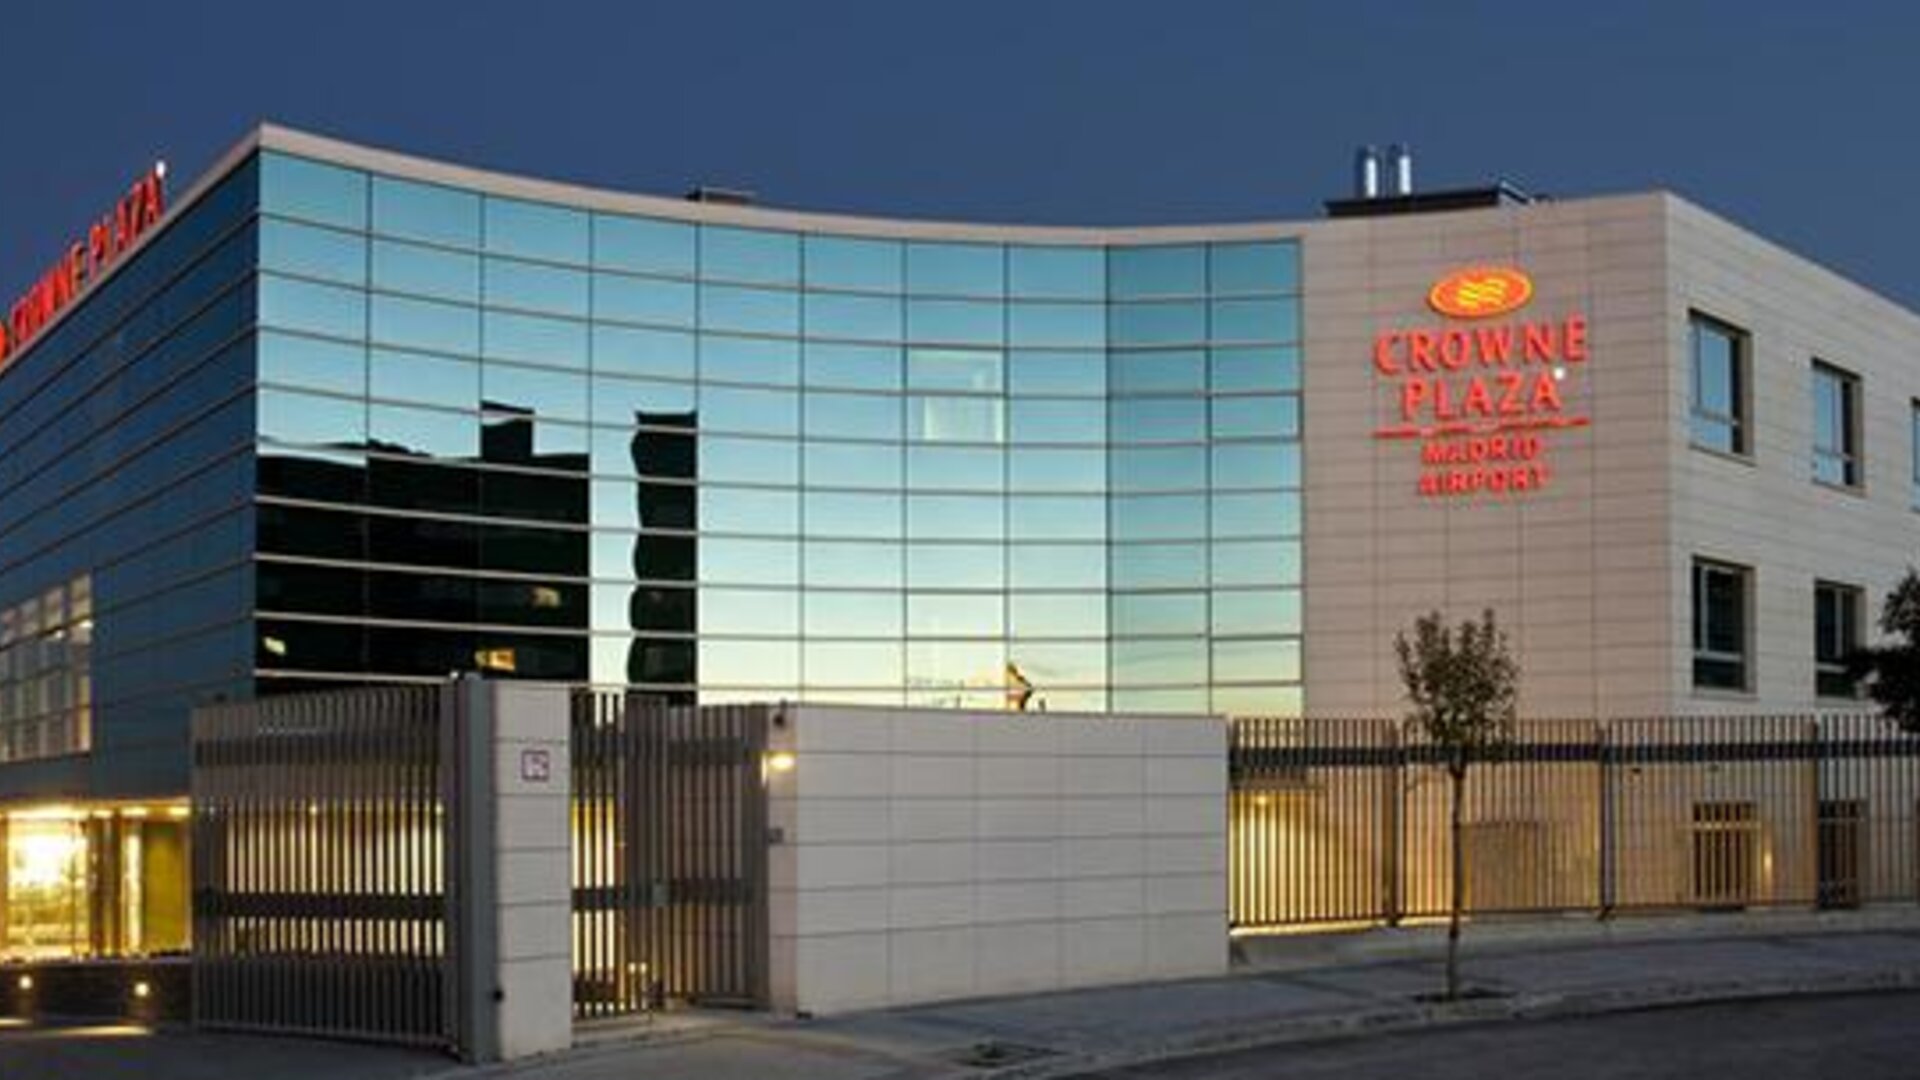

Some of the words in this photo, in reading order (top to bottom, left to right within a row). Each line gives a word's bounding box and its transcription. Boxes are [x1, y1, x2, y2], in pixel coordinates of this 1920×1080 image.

[87, 170, 165, 281] PLAZA
[1374, 315, 1588, 375] CROWNE
[1403, 370, 1563, 420] PLAZA
[1422, 434, 1541, 464] MADRID
[1419, 464, 1552, 496] AIRPORT
